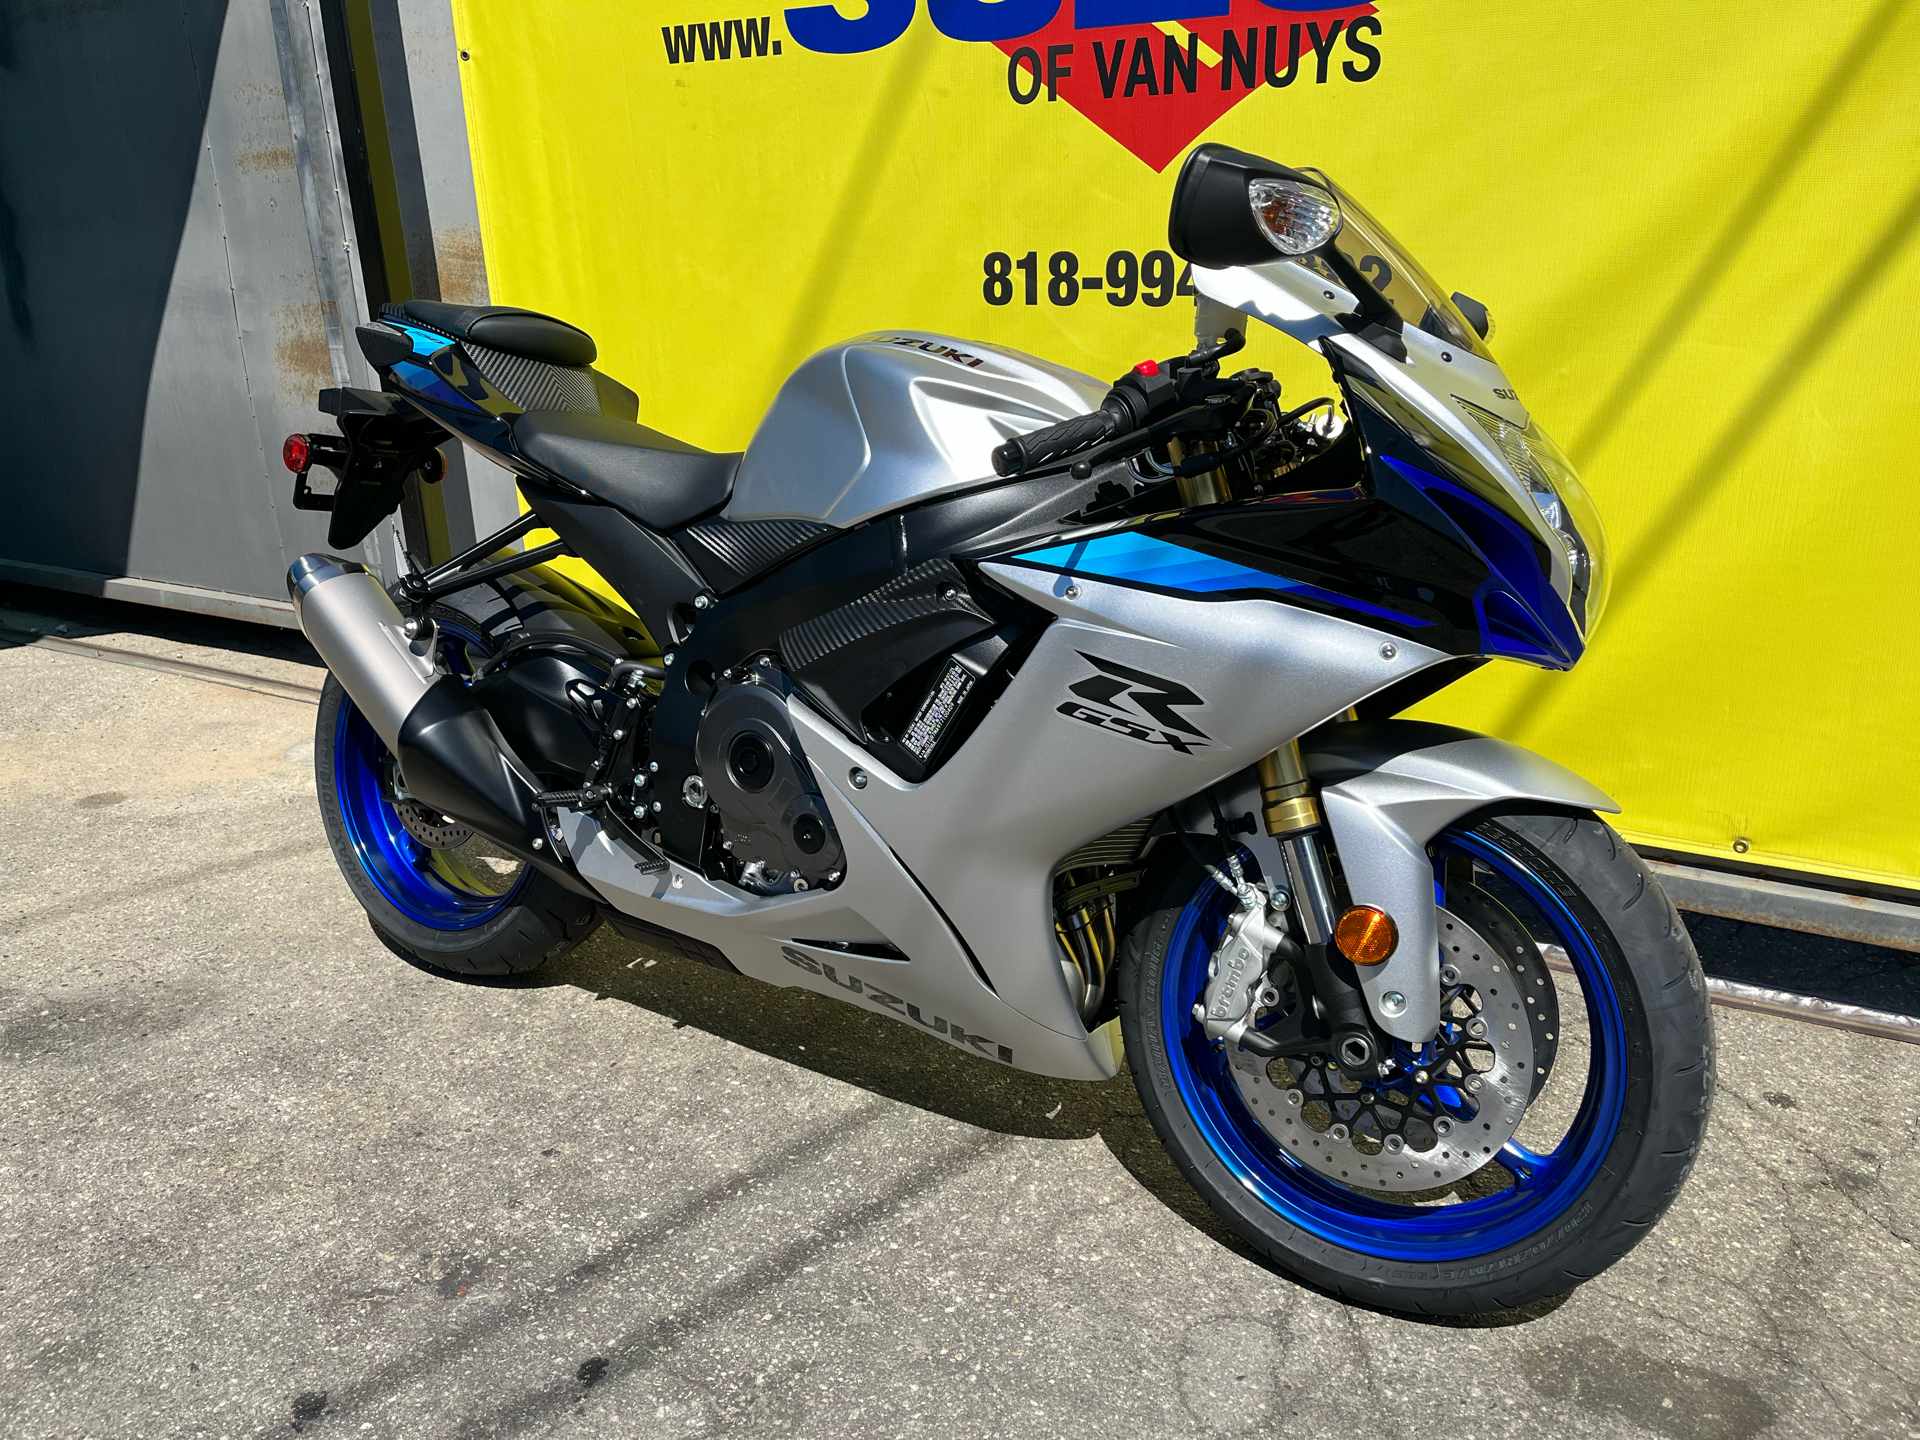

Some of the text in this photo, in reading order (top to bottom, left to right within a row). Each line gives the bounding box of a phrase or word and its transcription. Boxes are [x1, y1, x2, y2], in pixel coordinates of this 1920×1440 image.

[661, 16, 782, 64] www.
[1008, 43, 1074, 105] OF
[1092, 33, 1198, 99] VAN
[1221, 15, 1383, 92] NUYS
[1056, 701, 1212, 756] GSX
[781, 946, 1013, 1064] SUZUKI
[1211, 948, 1251, 1018] brembo
